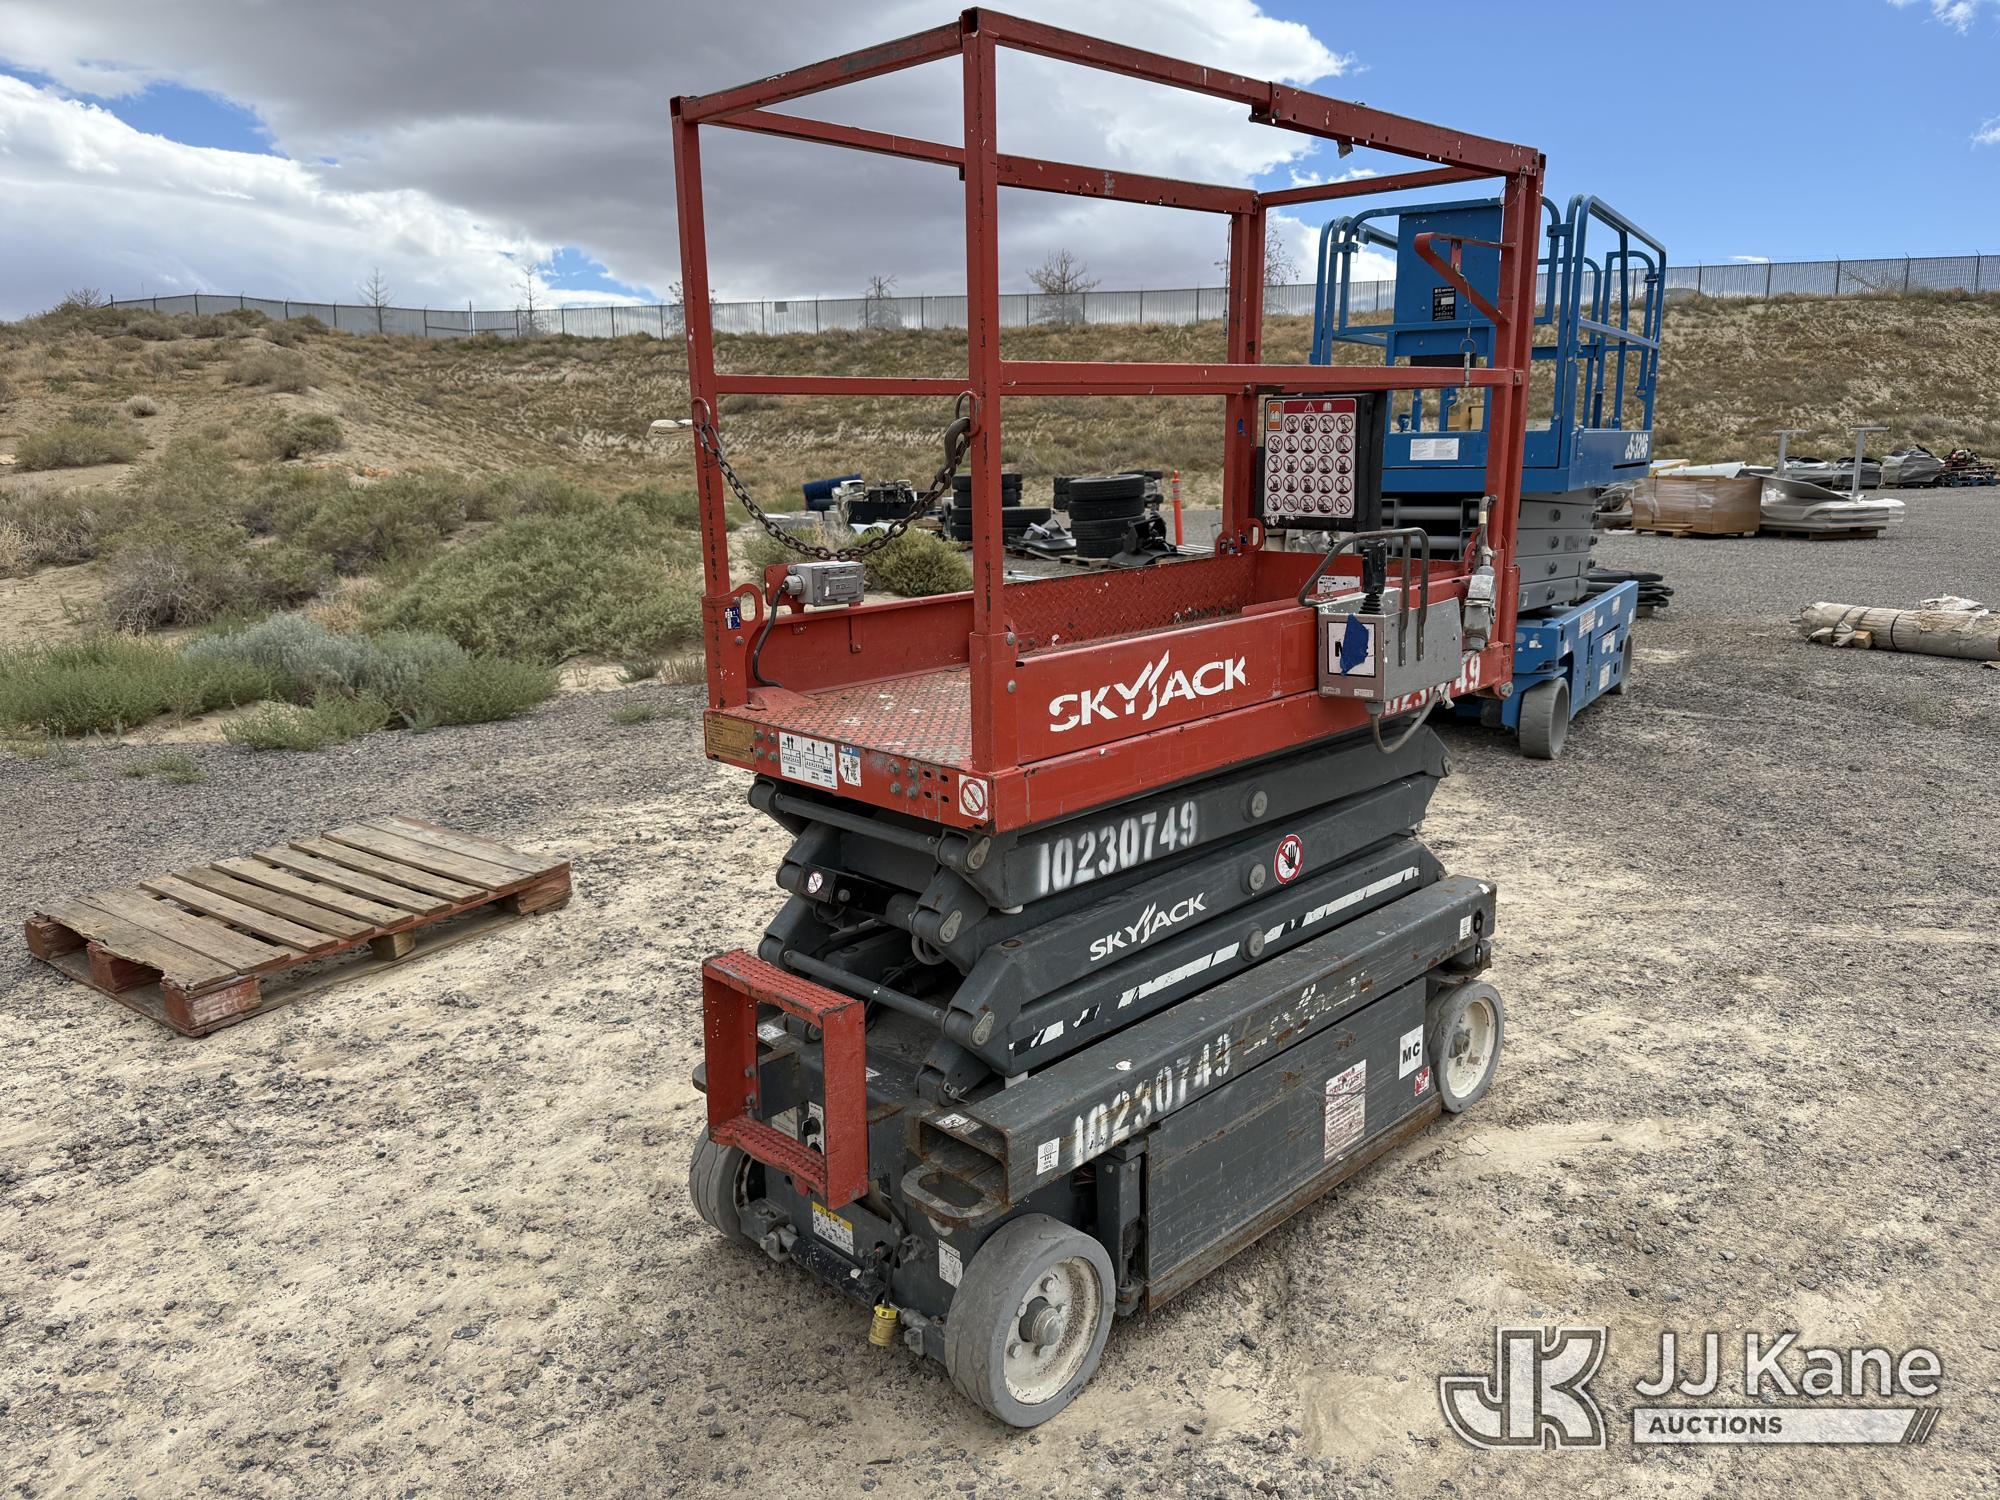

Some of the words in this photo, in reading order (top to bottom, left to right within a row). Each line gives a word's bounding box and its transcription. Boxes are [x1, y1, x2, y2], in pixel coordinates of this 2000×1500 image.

[1049, 649, 1246, 732] SKYJACK
[1039, 800, 1199, 895] 10230749
[1089, 892, 1207, 961] SKYJACK
[1402, 1041, 1421, 1064] MC
